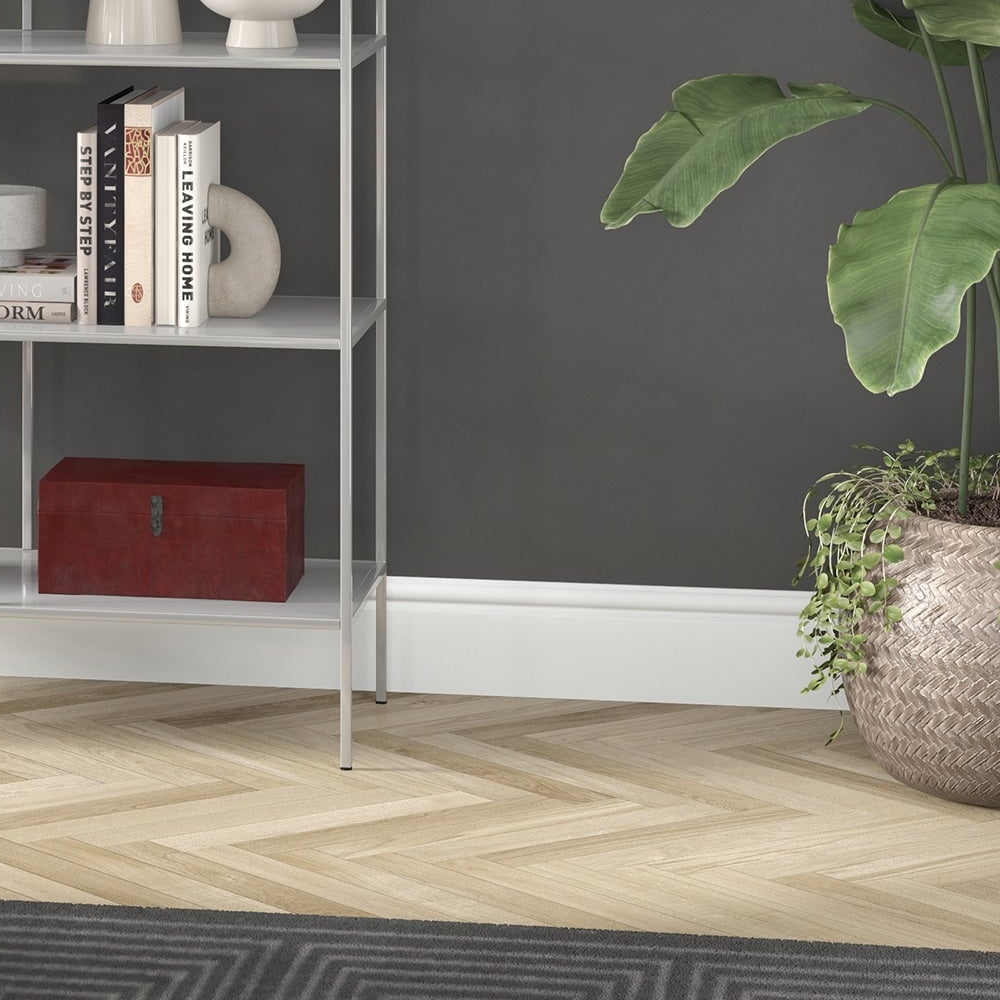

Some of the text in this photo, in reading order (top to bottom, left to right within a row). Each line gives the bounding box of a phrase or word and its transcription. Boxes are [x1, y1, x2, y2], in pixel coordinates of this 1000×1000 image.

[80, 146, 92, 256] STEP BY STEP
[182, 171, 194, 301] LEAVING HOME
